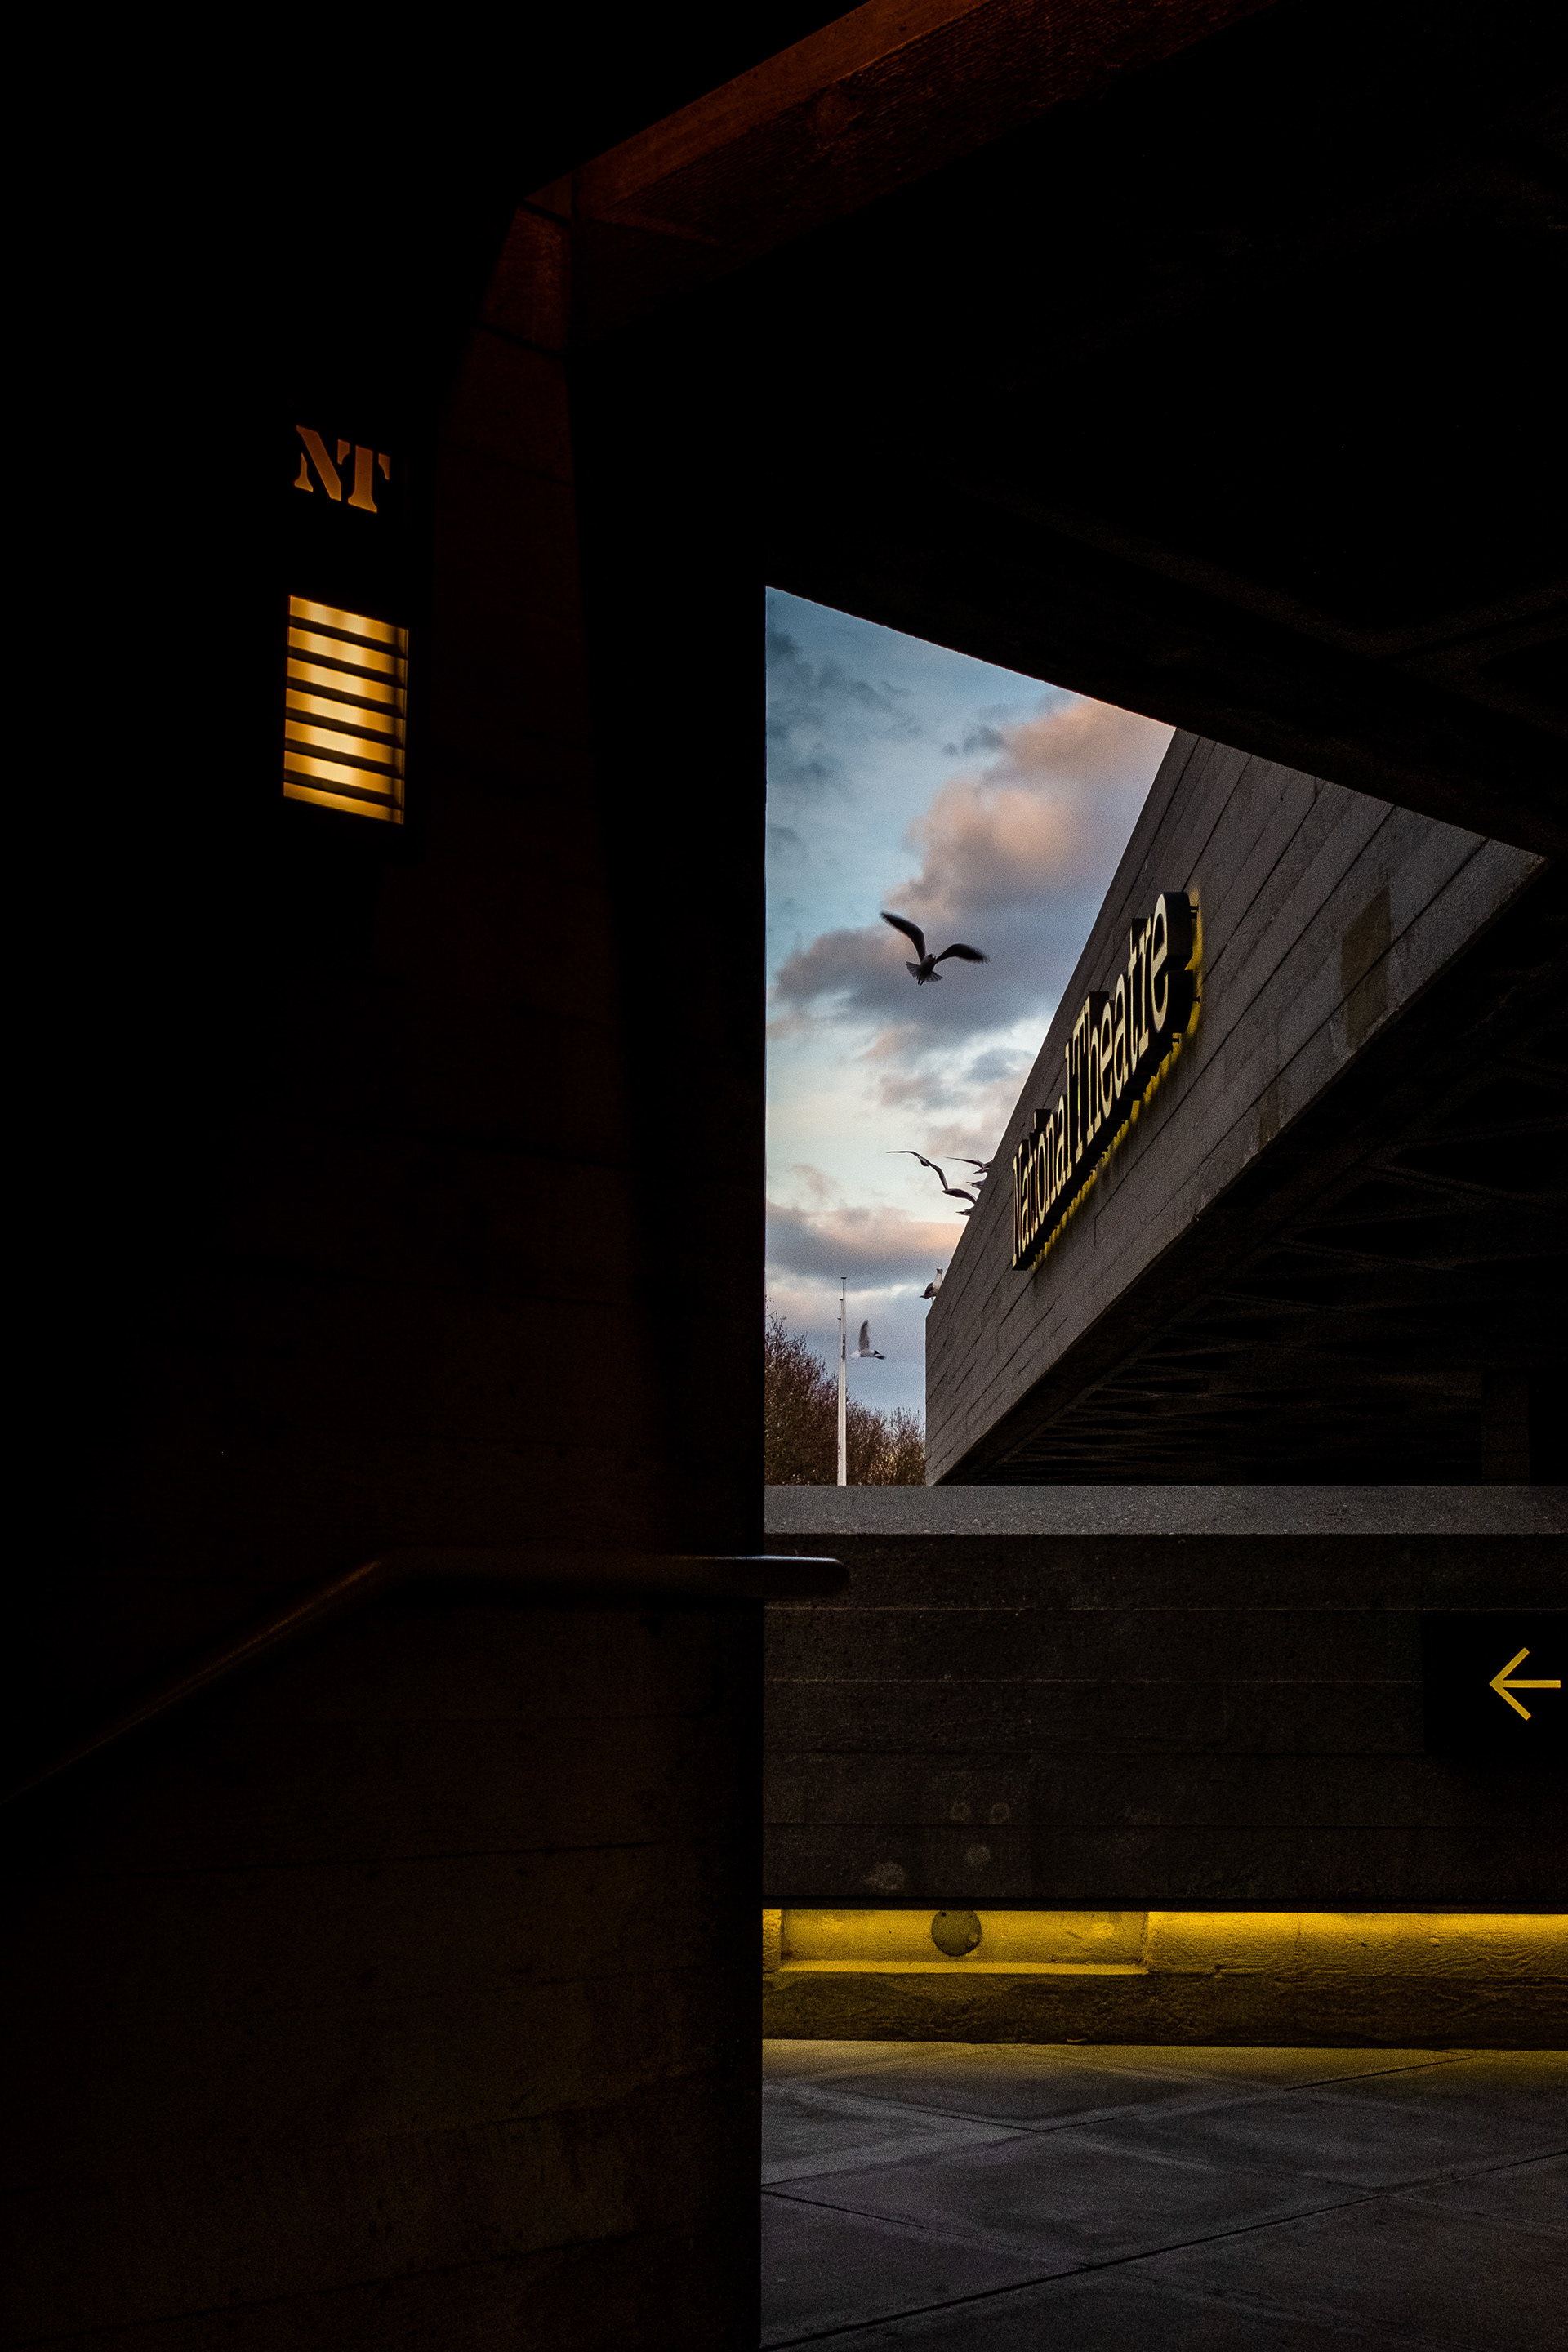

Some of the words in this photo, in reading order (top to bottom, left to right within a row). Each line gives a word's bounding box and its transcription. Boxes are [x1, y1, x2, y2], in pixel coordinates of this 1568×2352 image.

[294, 425, 390, 513] NT
[1012, 1039, 1073, 1269] National
[1072, 892, 1174, 1165] Theatre
